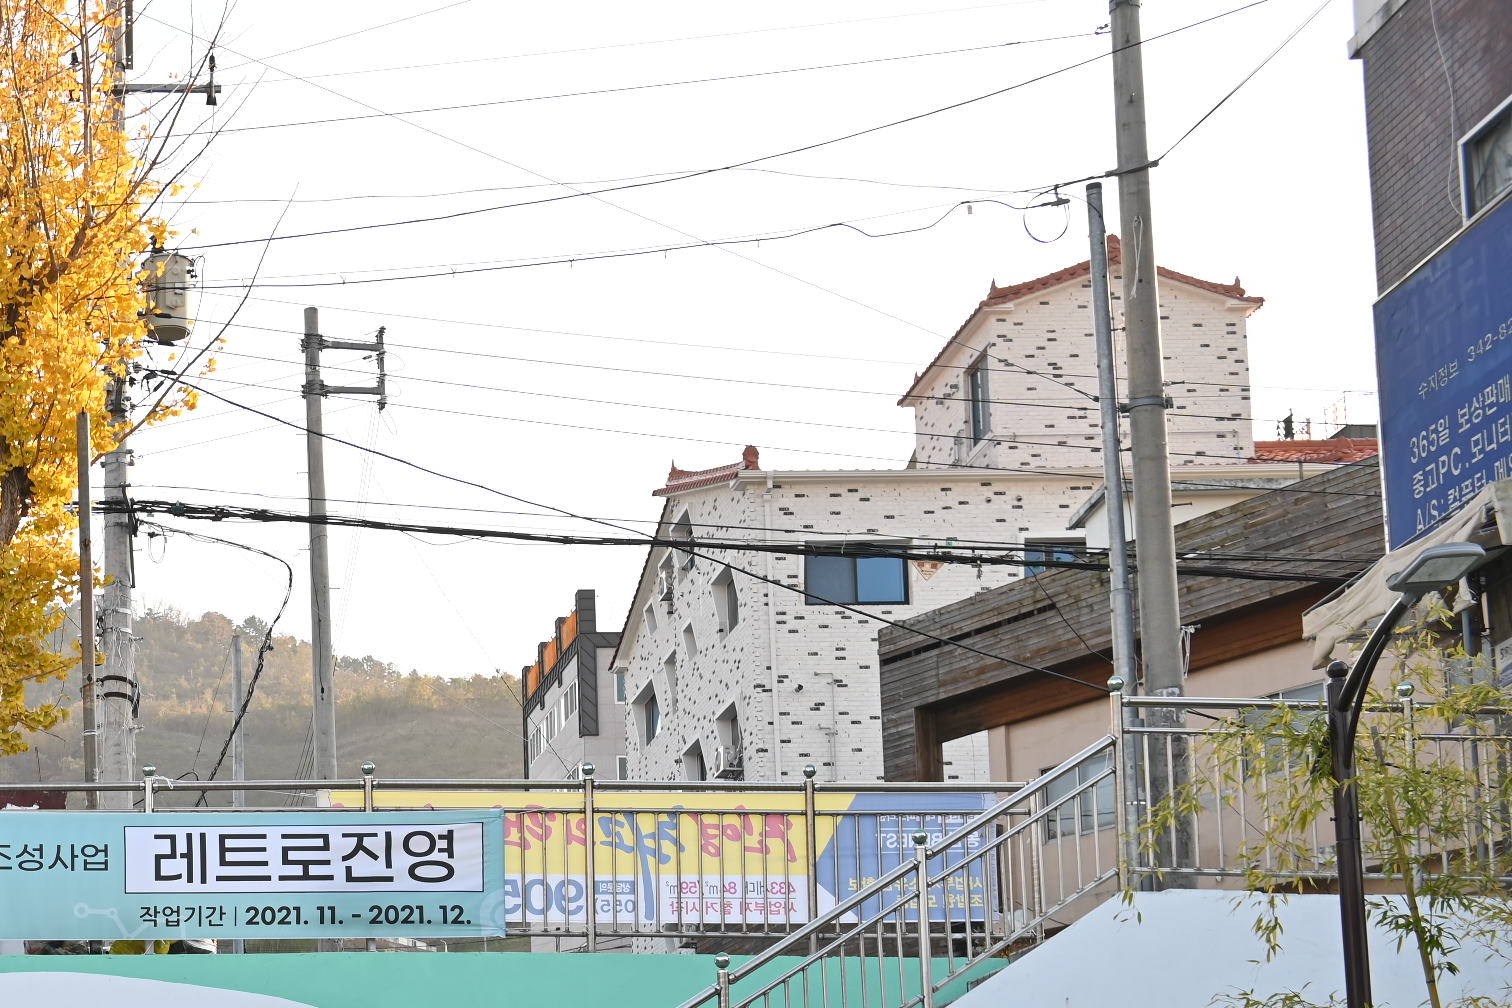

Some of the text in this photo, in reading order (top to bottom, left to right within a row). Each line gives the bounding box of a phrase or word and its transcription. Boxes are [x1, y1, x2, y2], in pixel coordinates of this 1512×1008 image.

[1410, 373, 1511, 463] 365일 보상판매
[153, 829, 455, 884] 레트로진영
[139, 905, 226, 928] 작업기간
[245, 905, 308, 926] 2021.
[316, 905, 344, 926] 11.
[368, 904, 432, 926] 2021.
[439, 904, 472, 925] 12.
